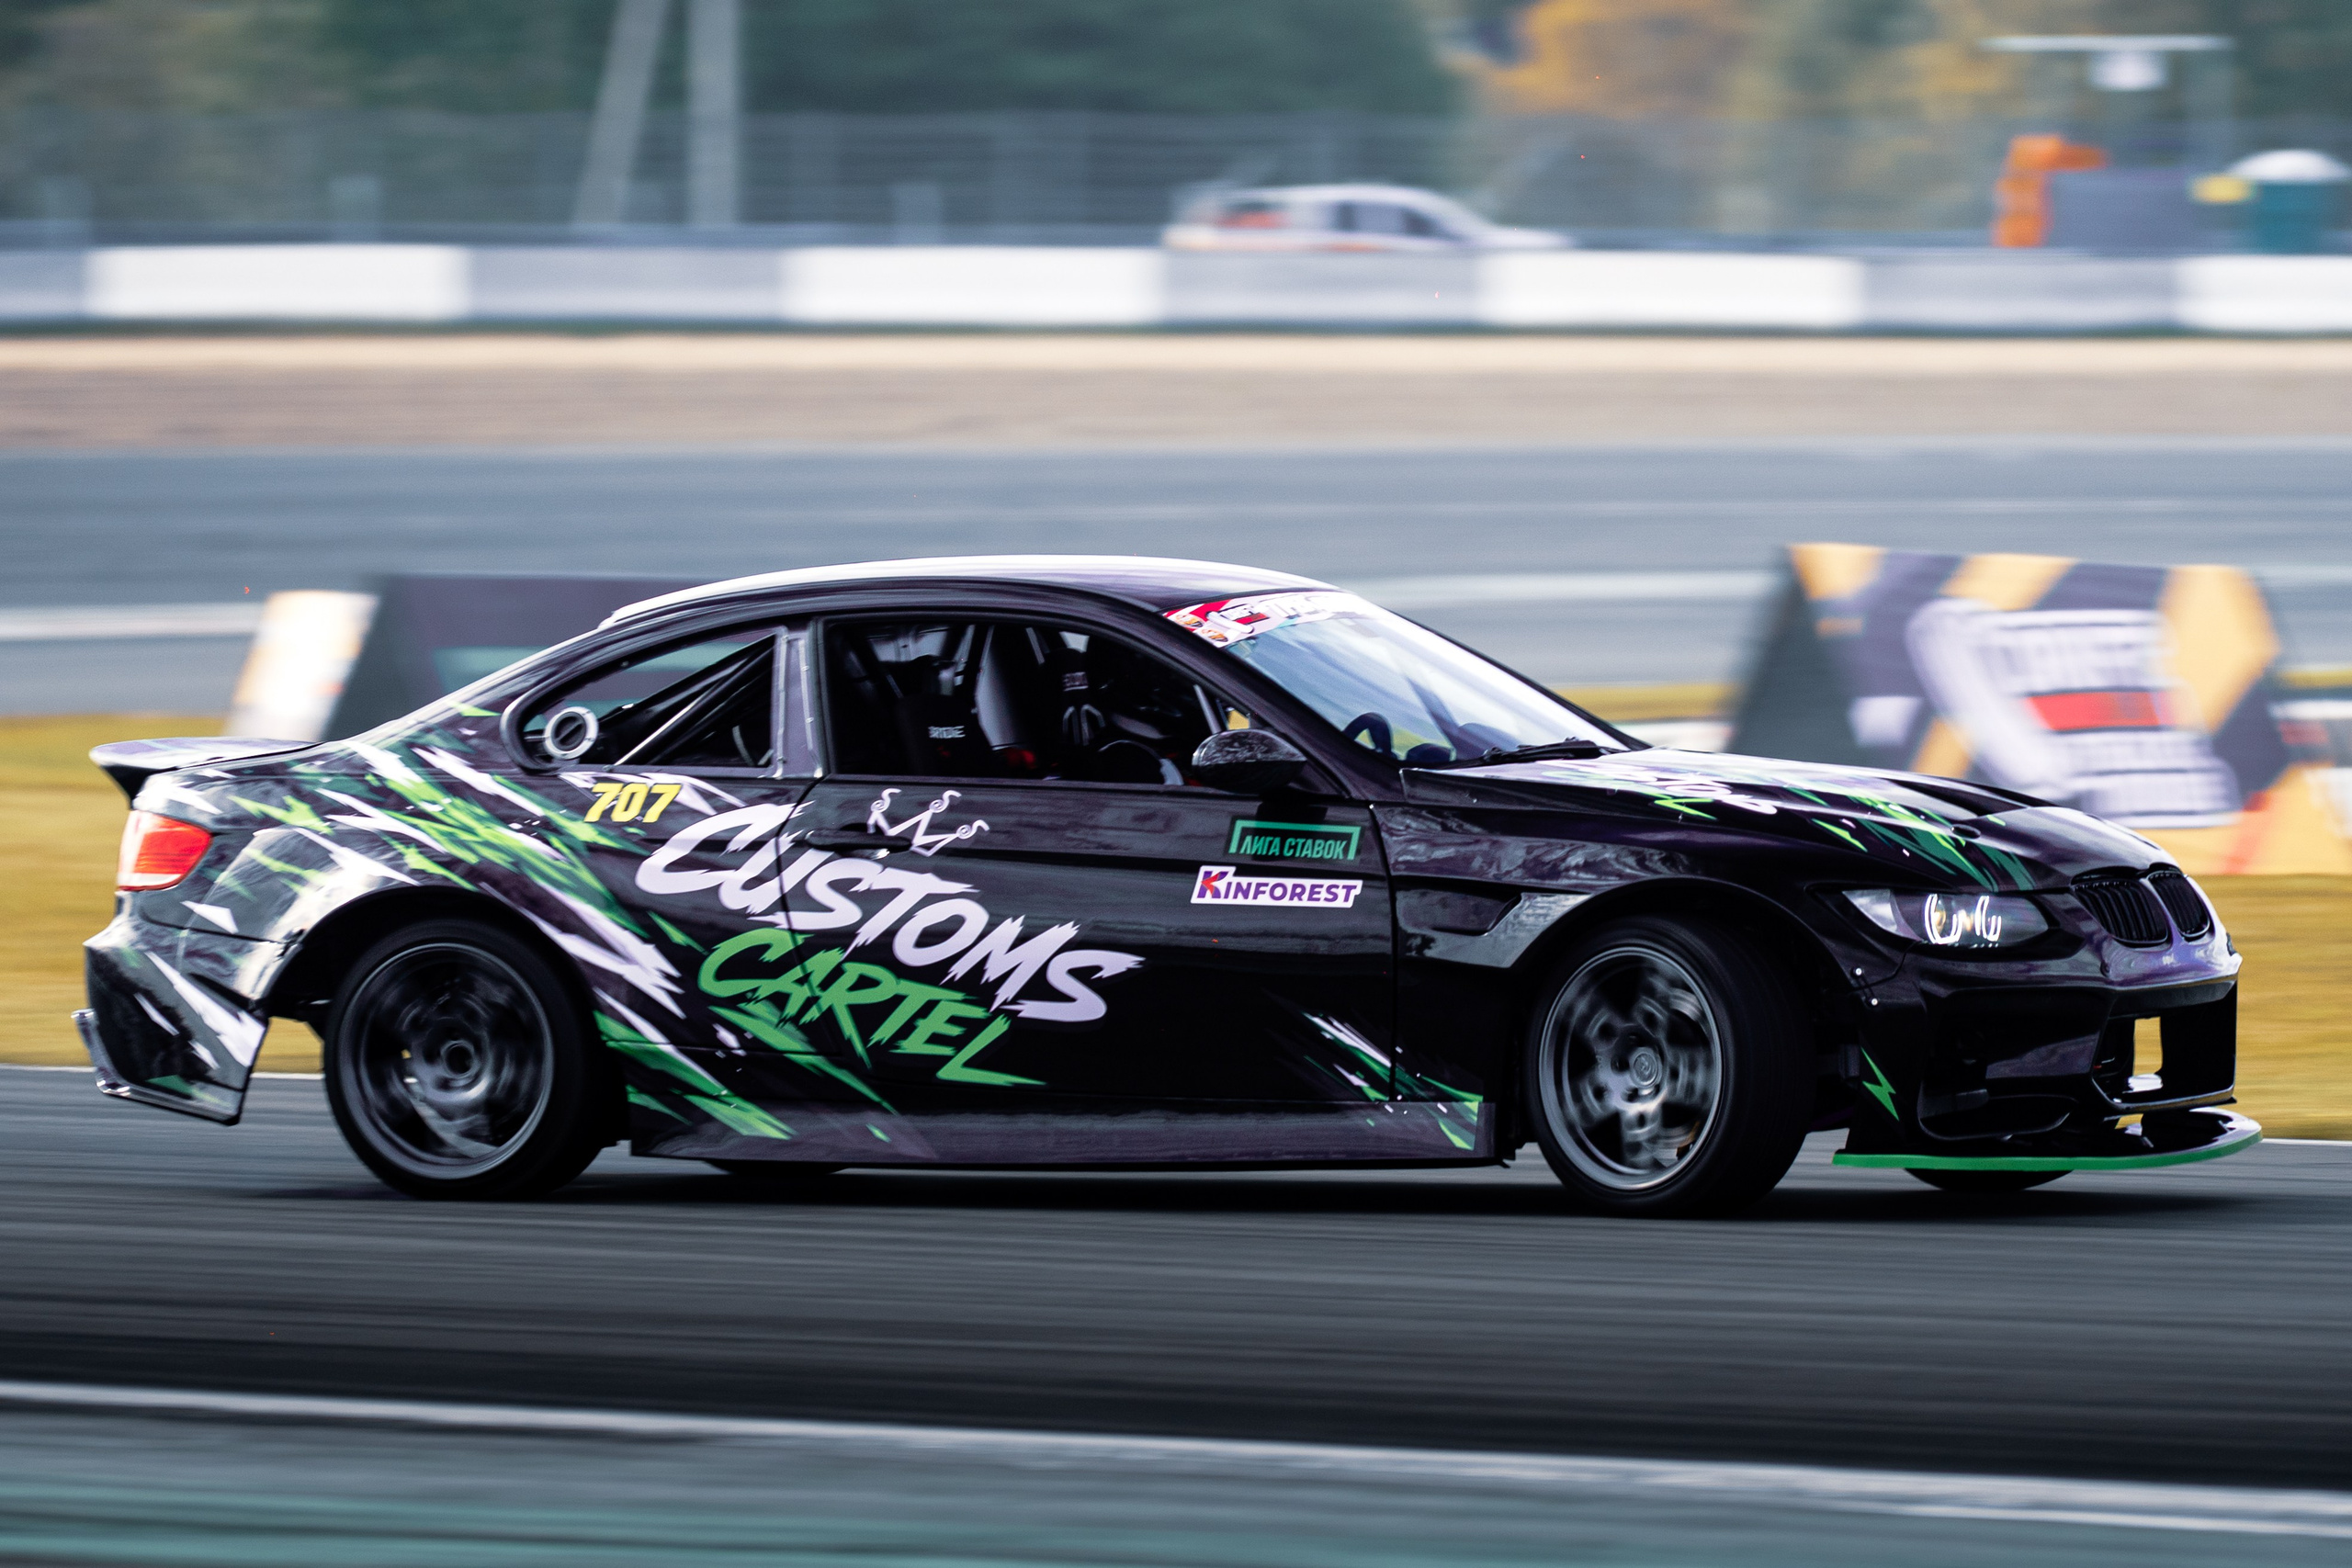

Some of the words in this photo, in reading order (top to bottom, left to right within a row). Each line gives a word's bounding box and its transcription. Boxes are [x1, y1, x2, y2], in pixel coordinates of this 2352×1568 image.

[583, 782, 682, 823] 707
[1239, 835, 1282, 855] ЛИГА
[1283, 838, 1347, 860] СТАВОК
[1197, 870, 1357, 903] KINFOREST
[636, 800, 1145, 1021] CUSTOMS
[698, 928, 1046, 1086] CARTEL
